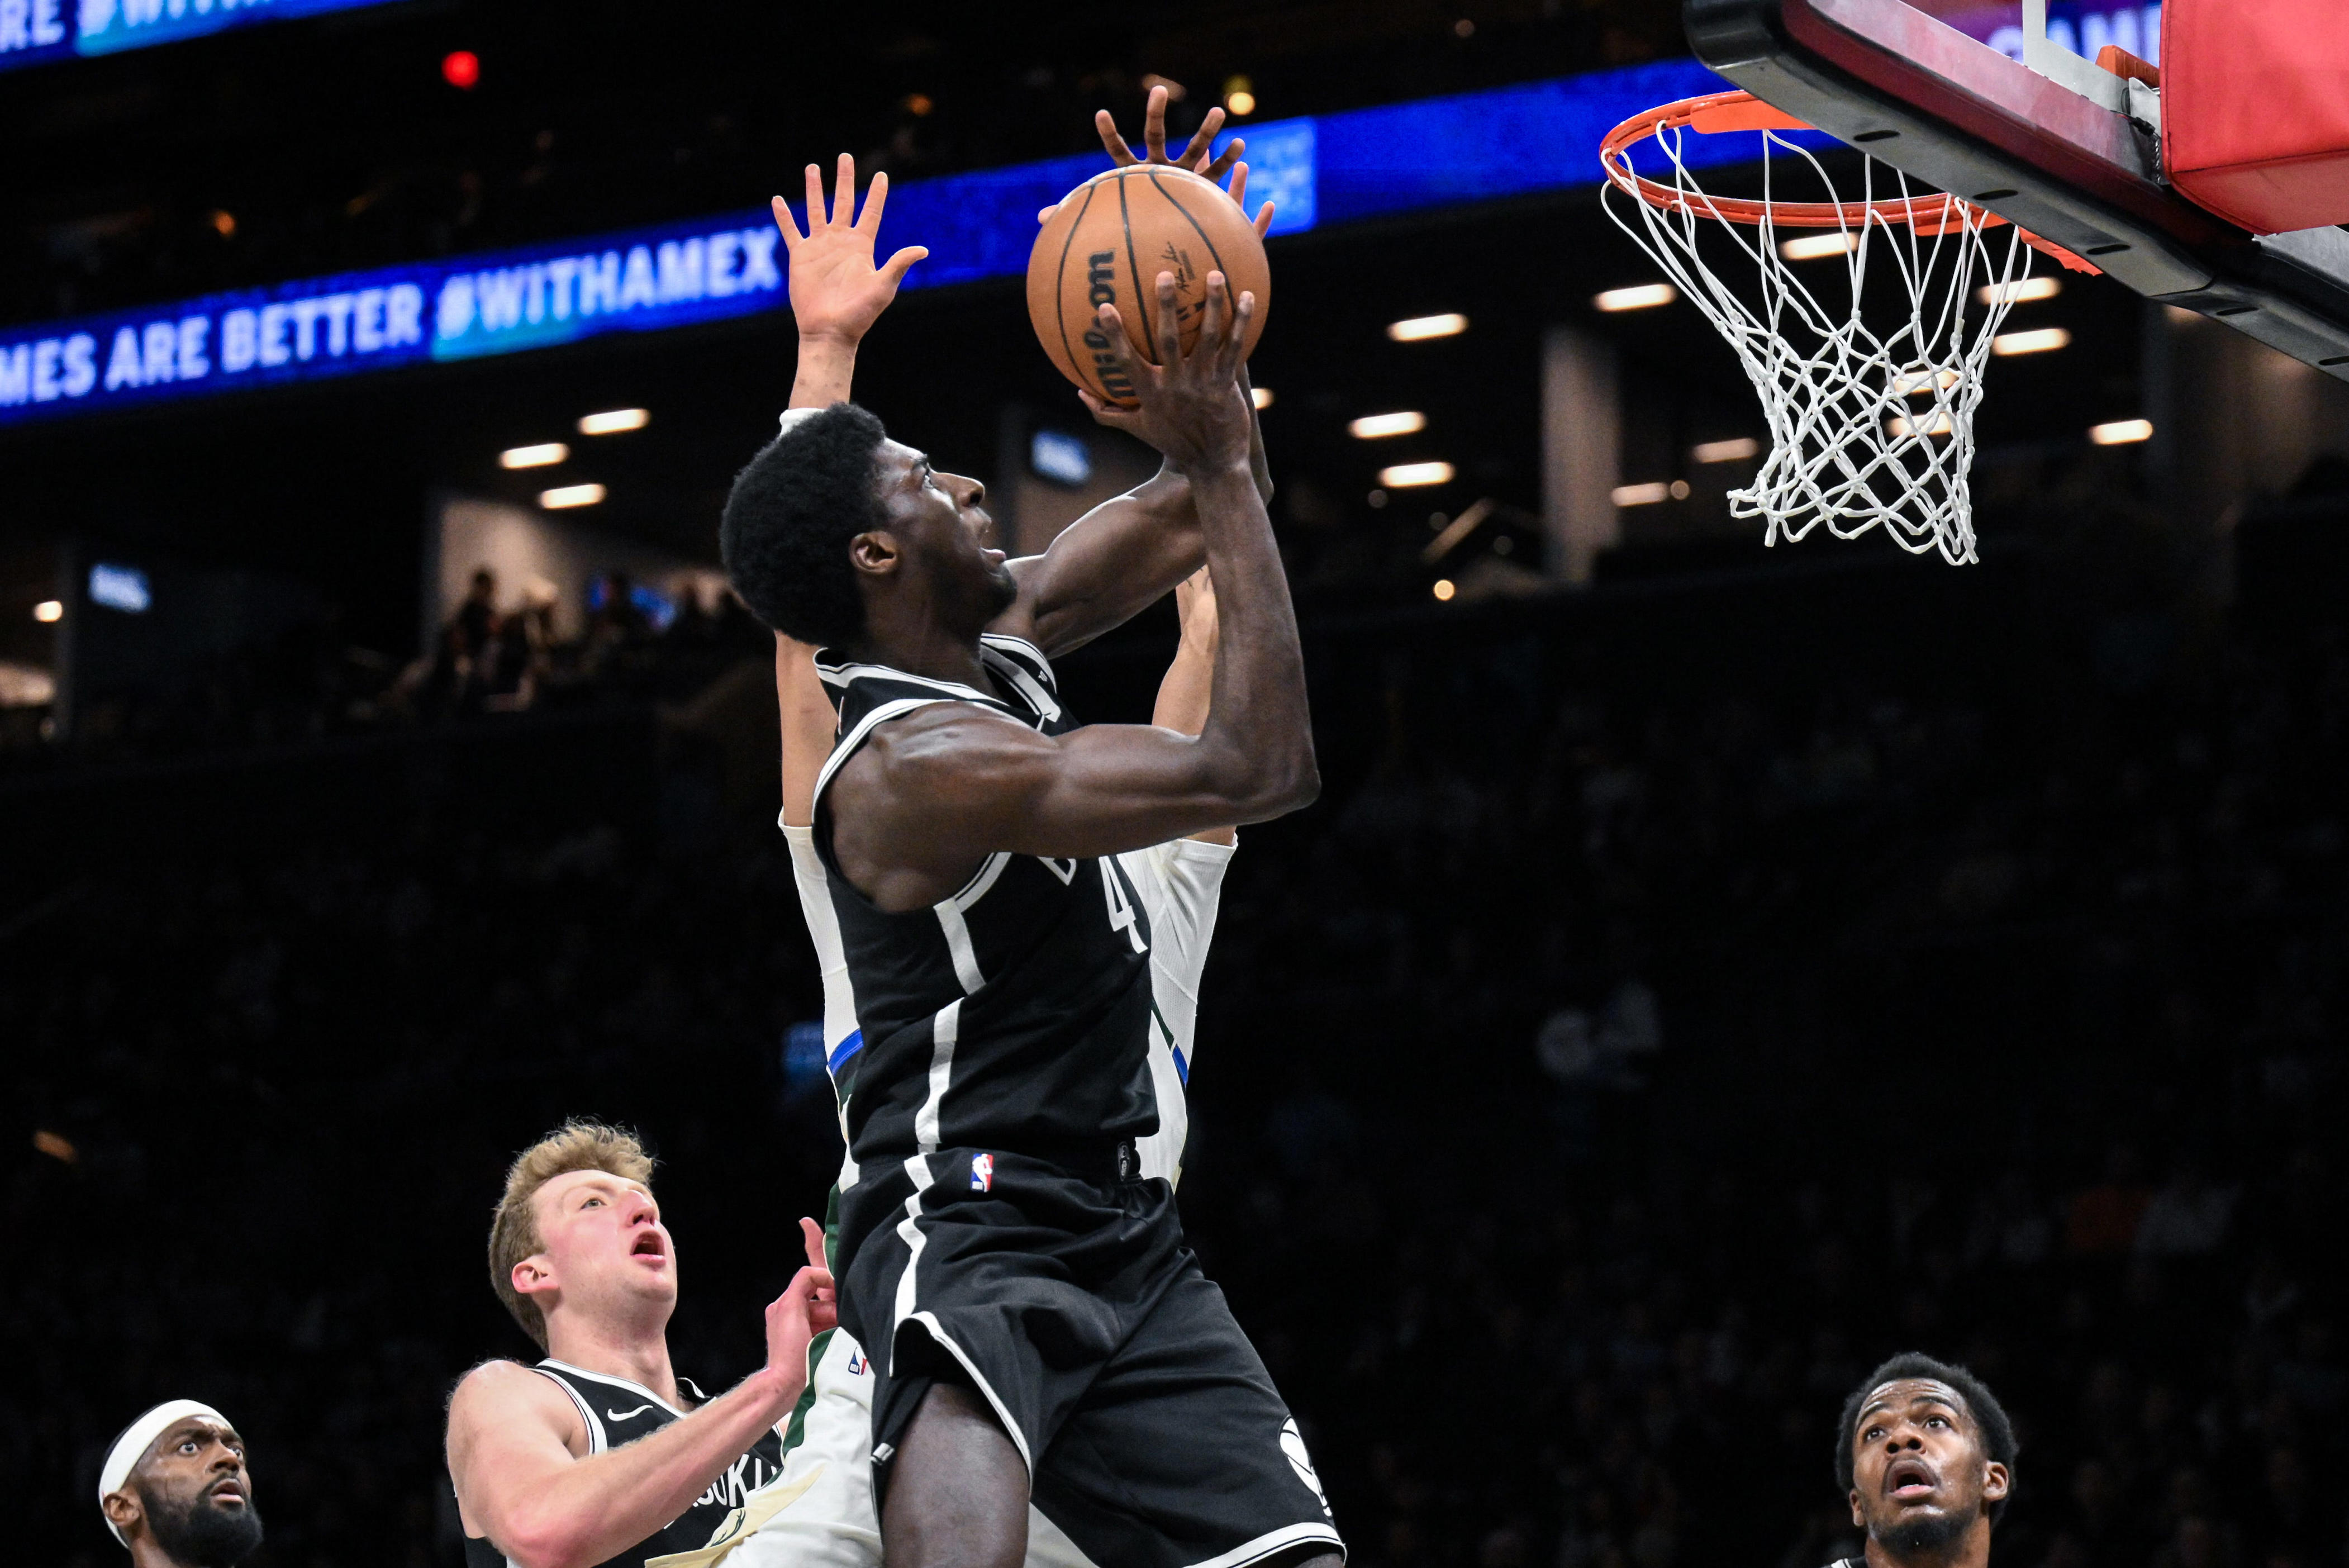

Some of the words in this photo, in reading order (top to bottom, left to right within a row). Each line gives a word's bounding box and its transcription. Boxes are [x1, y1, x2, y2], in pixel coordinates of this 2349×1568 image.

[105, 316, 208, 389] ARE
[221, 283, 422, 371] BETTER
[436, 225, 778, 339] #WITHAMEX
